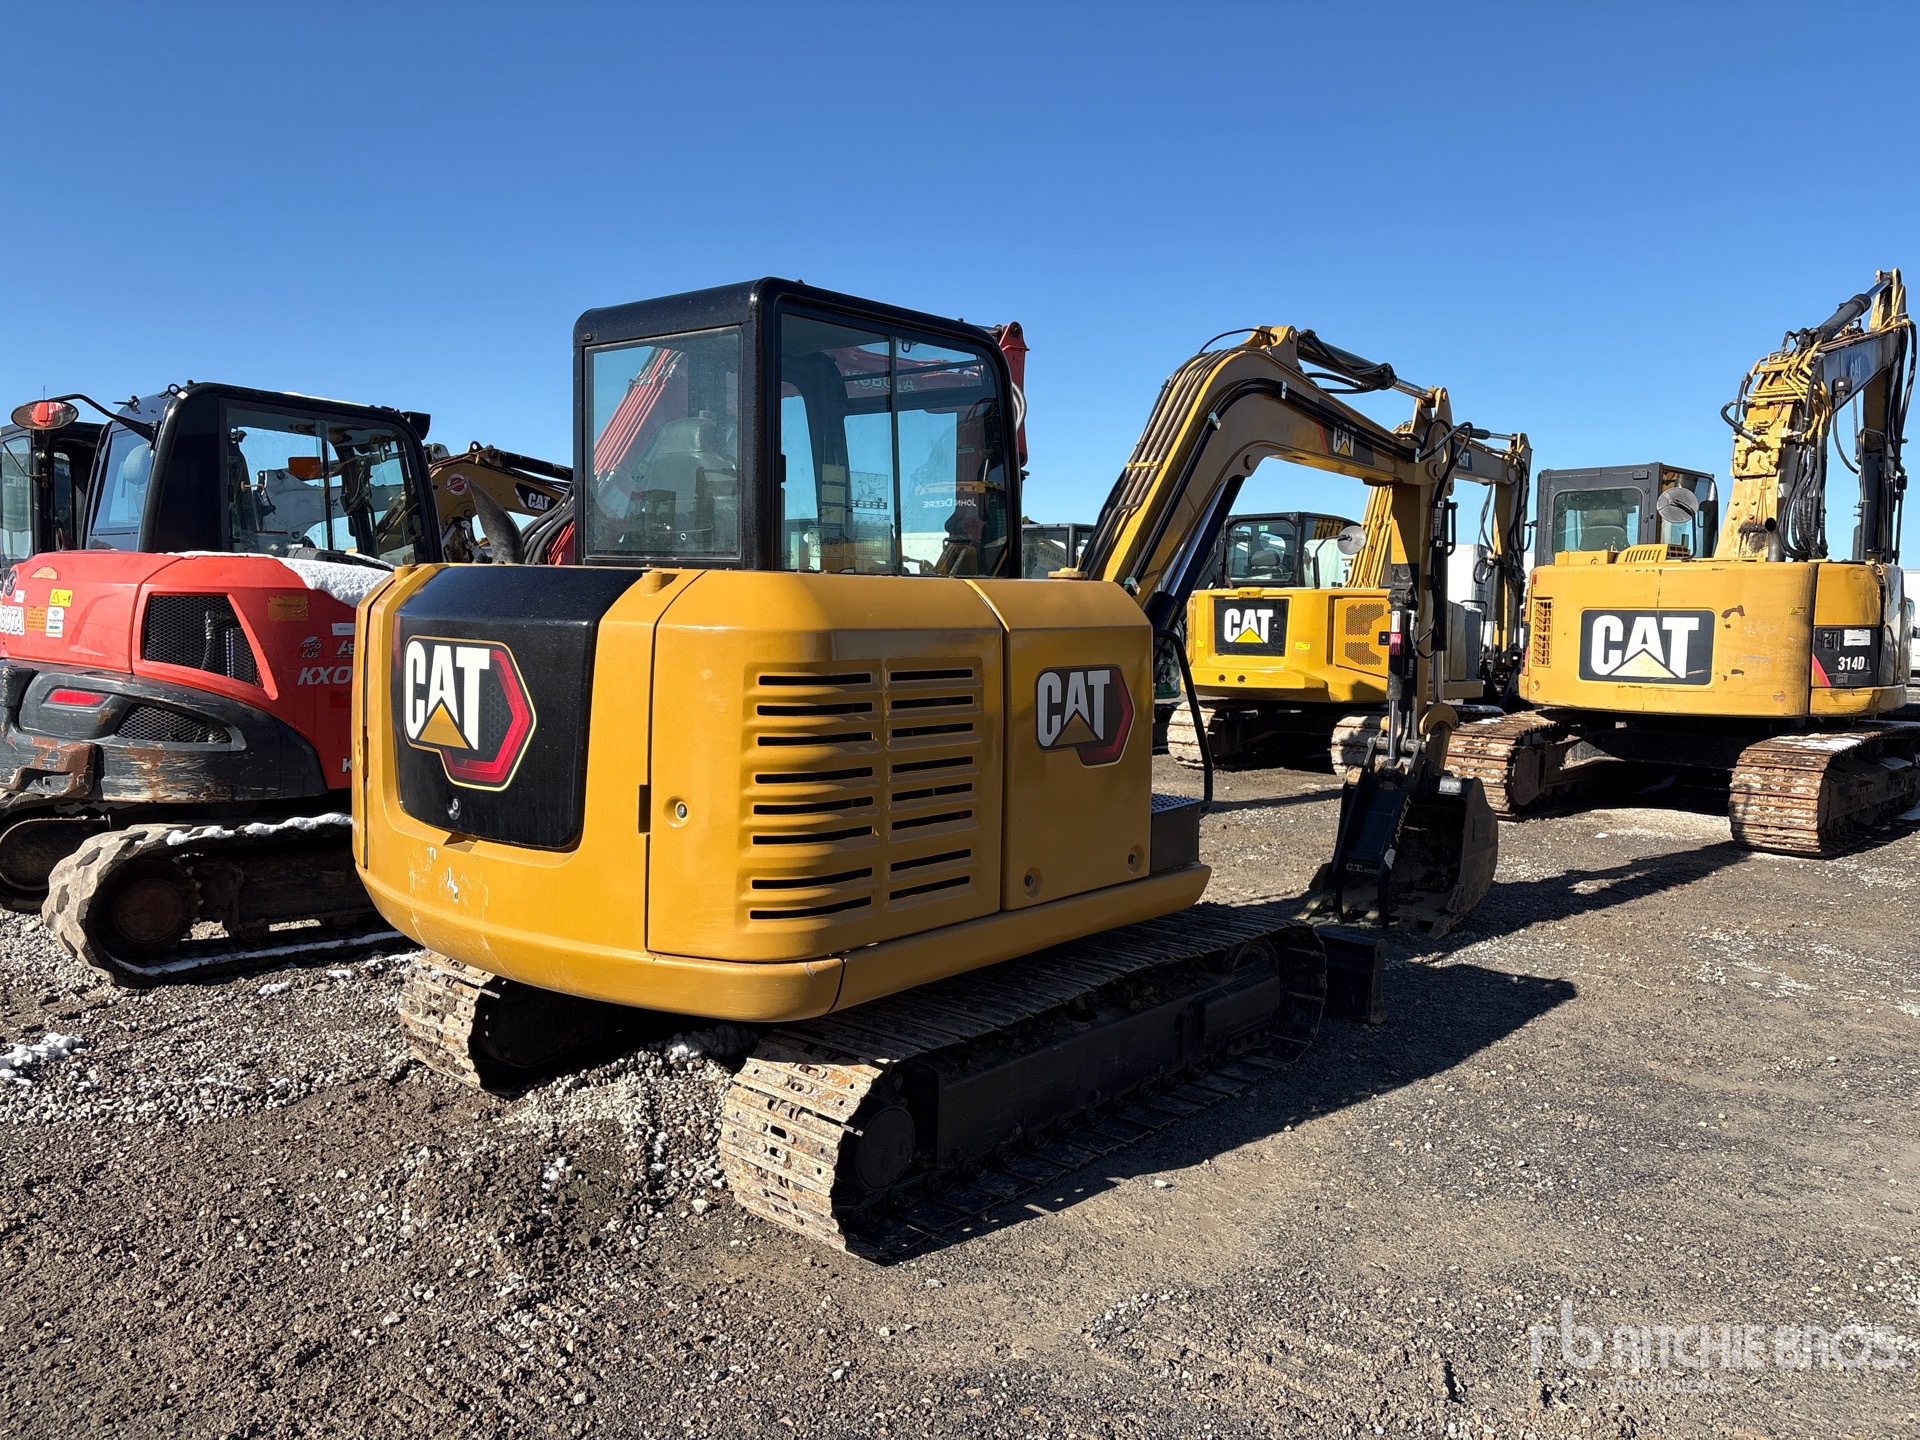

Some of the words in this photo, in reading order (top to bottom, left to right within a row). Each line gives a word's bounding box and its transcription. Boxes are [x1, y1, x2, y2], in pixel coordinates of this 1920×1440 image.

[527, 492, 551, 511] CAT
[0, 606, 24, 634] BOTA
[1224, 608, 1273, 644] CAT
[1590, 615, 1699, 678] CAT
[1837, 656, 1865, 671] 314D
[406, 641, 490, 750] CAT
[1038, 670, 1110, 747] CAT
[1394, 794, 1412, 844] AMULET
